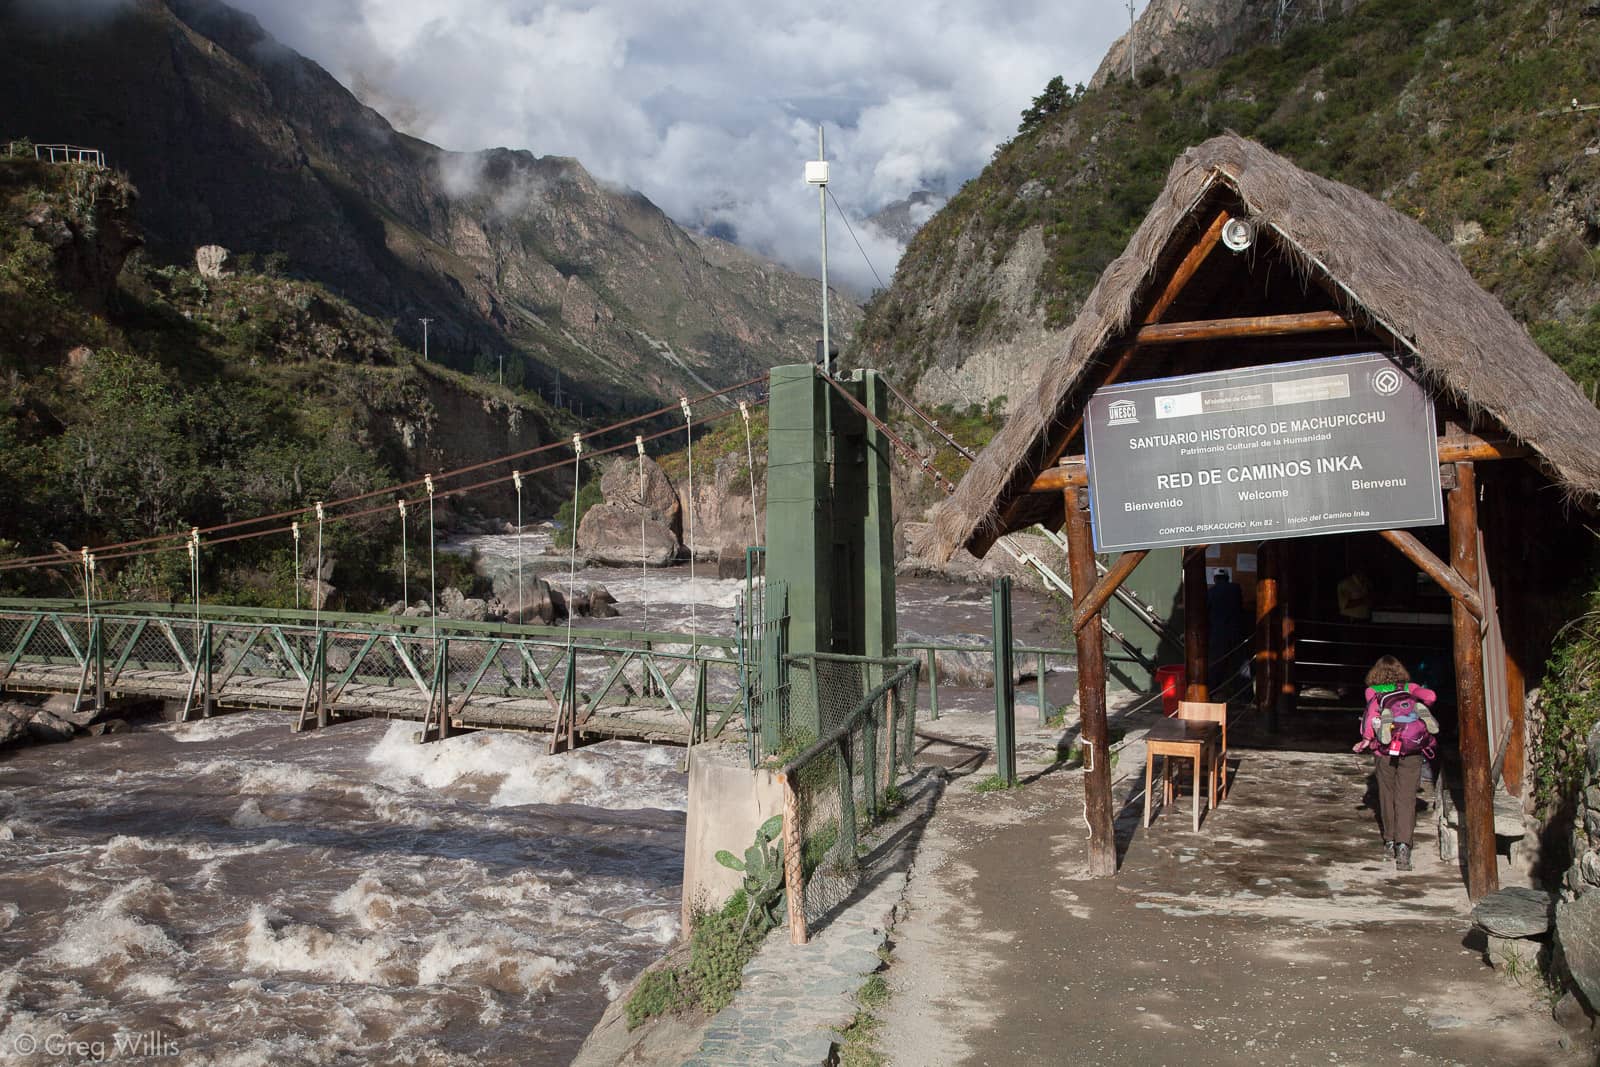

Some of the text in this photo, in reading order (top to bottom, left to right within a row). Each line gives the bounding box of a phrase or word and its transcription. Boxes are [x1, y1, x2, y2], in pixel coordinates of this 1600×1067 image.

[1109, 406, 1137, 419] UNESCO
[1129, 411, 1386, 450] SANTUARIO HISTÓRICO DE MACHUPICCHU
[1180, 432, 1332, 456] Patrimonio Cultural de la Humanidad
[1157, 456, 1363, 489] RED DE CAMINOS INKA
[1124, 477, 1406, 512] Bienvenido Welcome Bienvenu
[1159, 525, 1195, 536] CONTROL
[1196, 521, 1247, 533] PISKACUCHO
[1250, 519, 1262, 528] Km
[1287, 516, 1307, 525] Inicio
[1310, 513, 1322, 522] del
[1323, 510, 1352, 520] Camino
[1354, 509, 1370, 518] Inka
